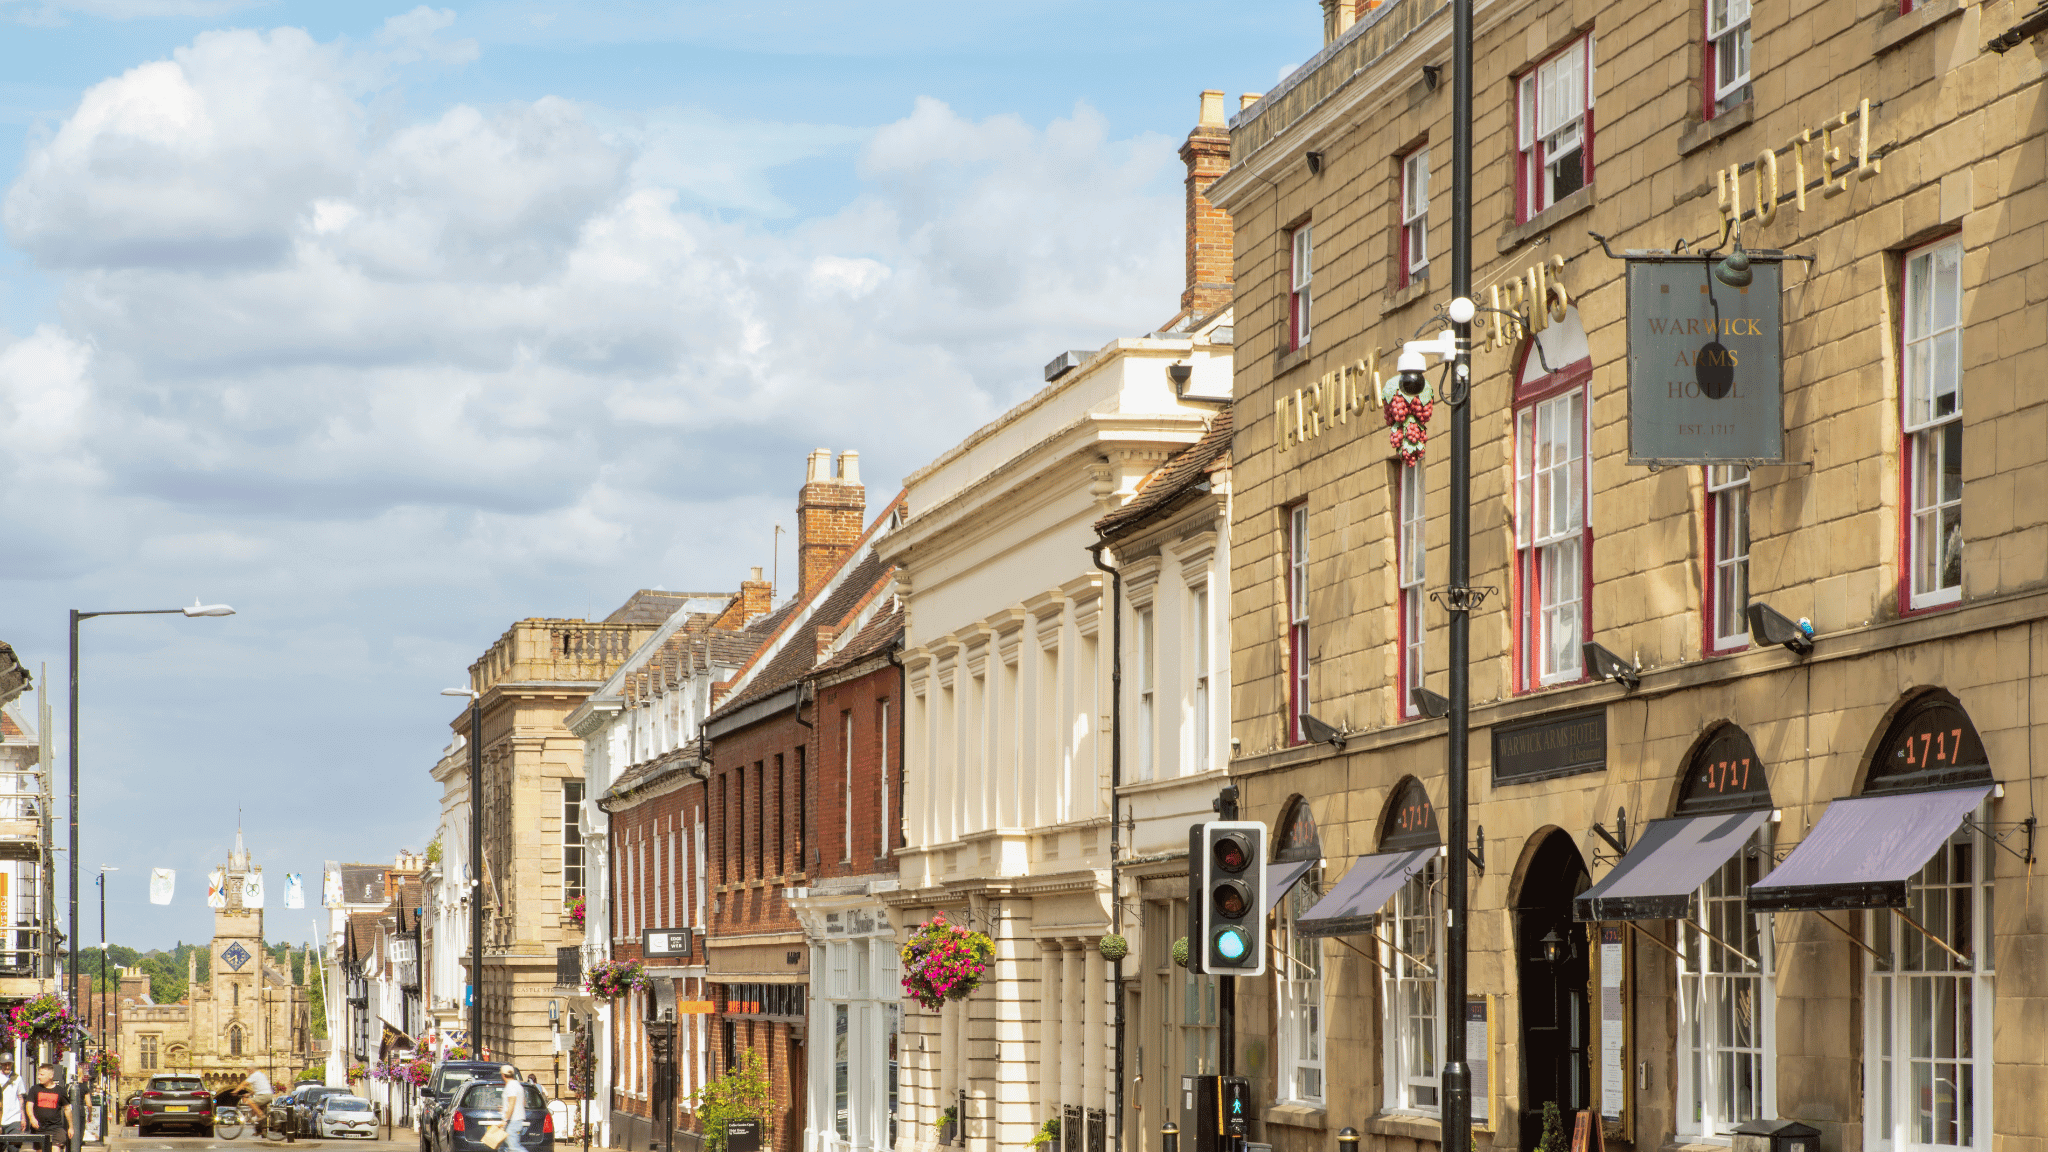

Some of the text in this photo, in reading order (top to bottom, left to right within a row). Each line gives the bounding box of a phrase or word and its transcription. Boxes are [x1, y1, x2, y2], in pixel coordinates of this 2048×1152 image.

[1276, 98, 1881, 453] WARWICK ARMS HOTEL
[1648, 318, 1763, 336] WARWICK
[1674, 349, 1739, 367] ARMS
[1679, 424, 1735, 435] EST. 1717
[1500, 721, 1601, 757] WARWICK ARMS HOTEL
[1906, 728, 1962, 768] 1717
[1708, 758, 1750, 793] 1717
[1293, 820, 1315, 843] 1717
[1402, 803, 1430, 832] 1717
